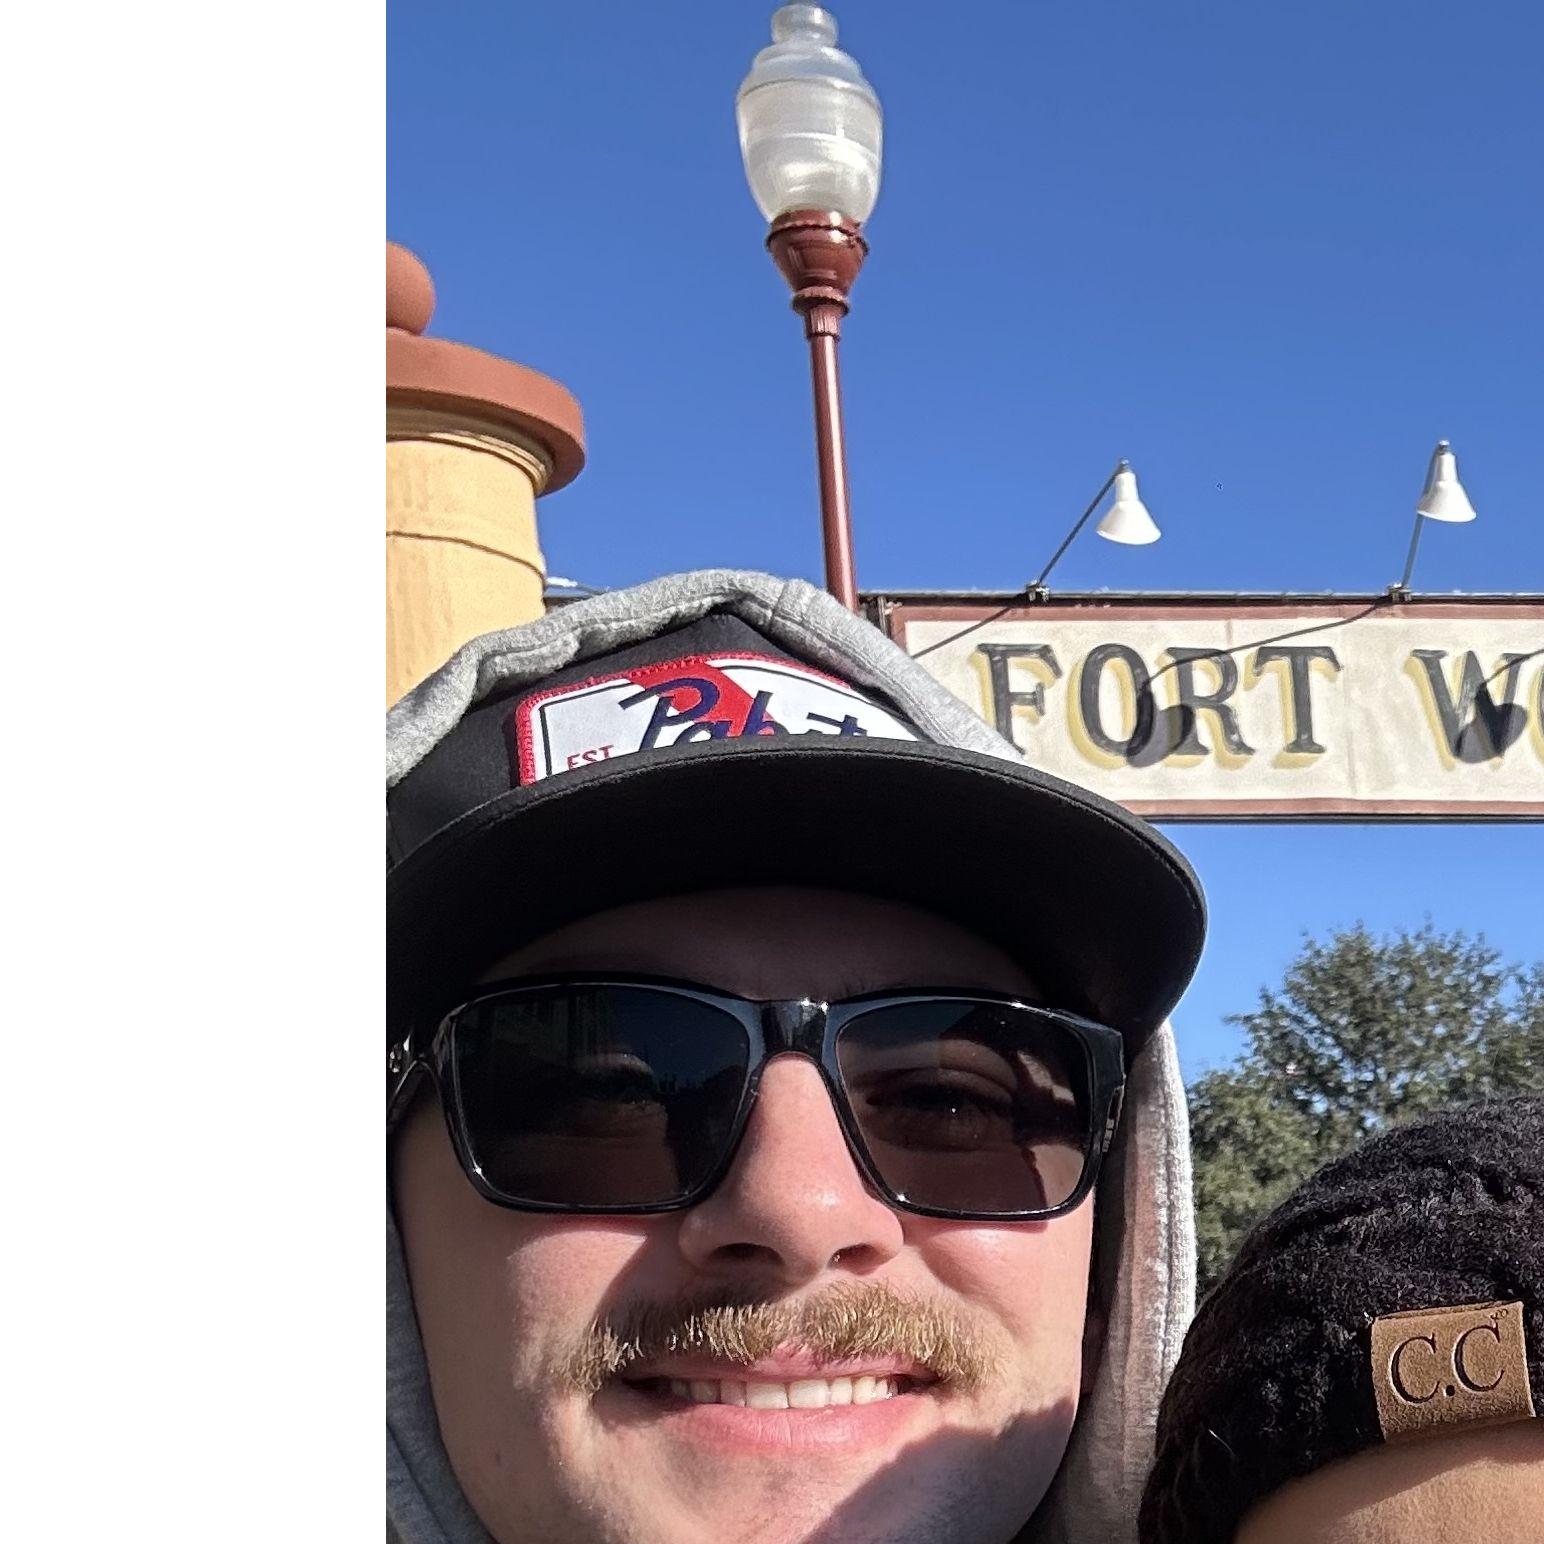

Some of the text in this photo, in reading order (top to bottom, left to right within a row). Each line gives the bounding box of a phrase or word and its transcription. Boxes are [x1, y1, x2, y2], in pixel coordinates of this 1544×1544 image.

[618, 677, 868, 751] Pabt
[970, 642, 1342, 764] FORT
[1389, 1318, 1505, 1405] C.C
